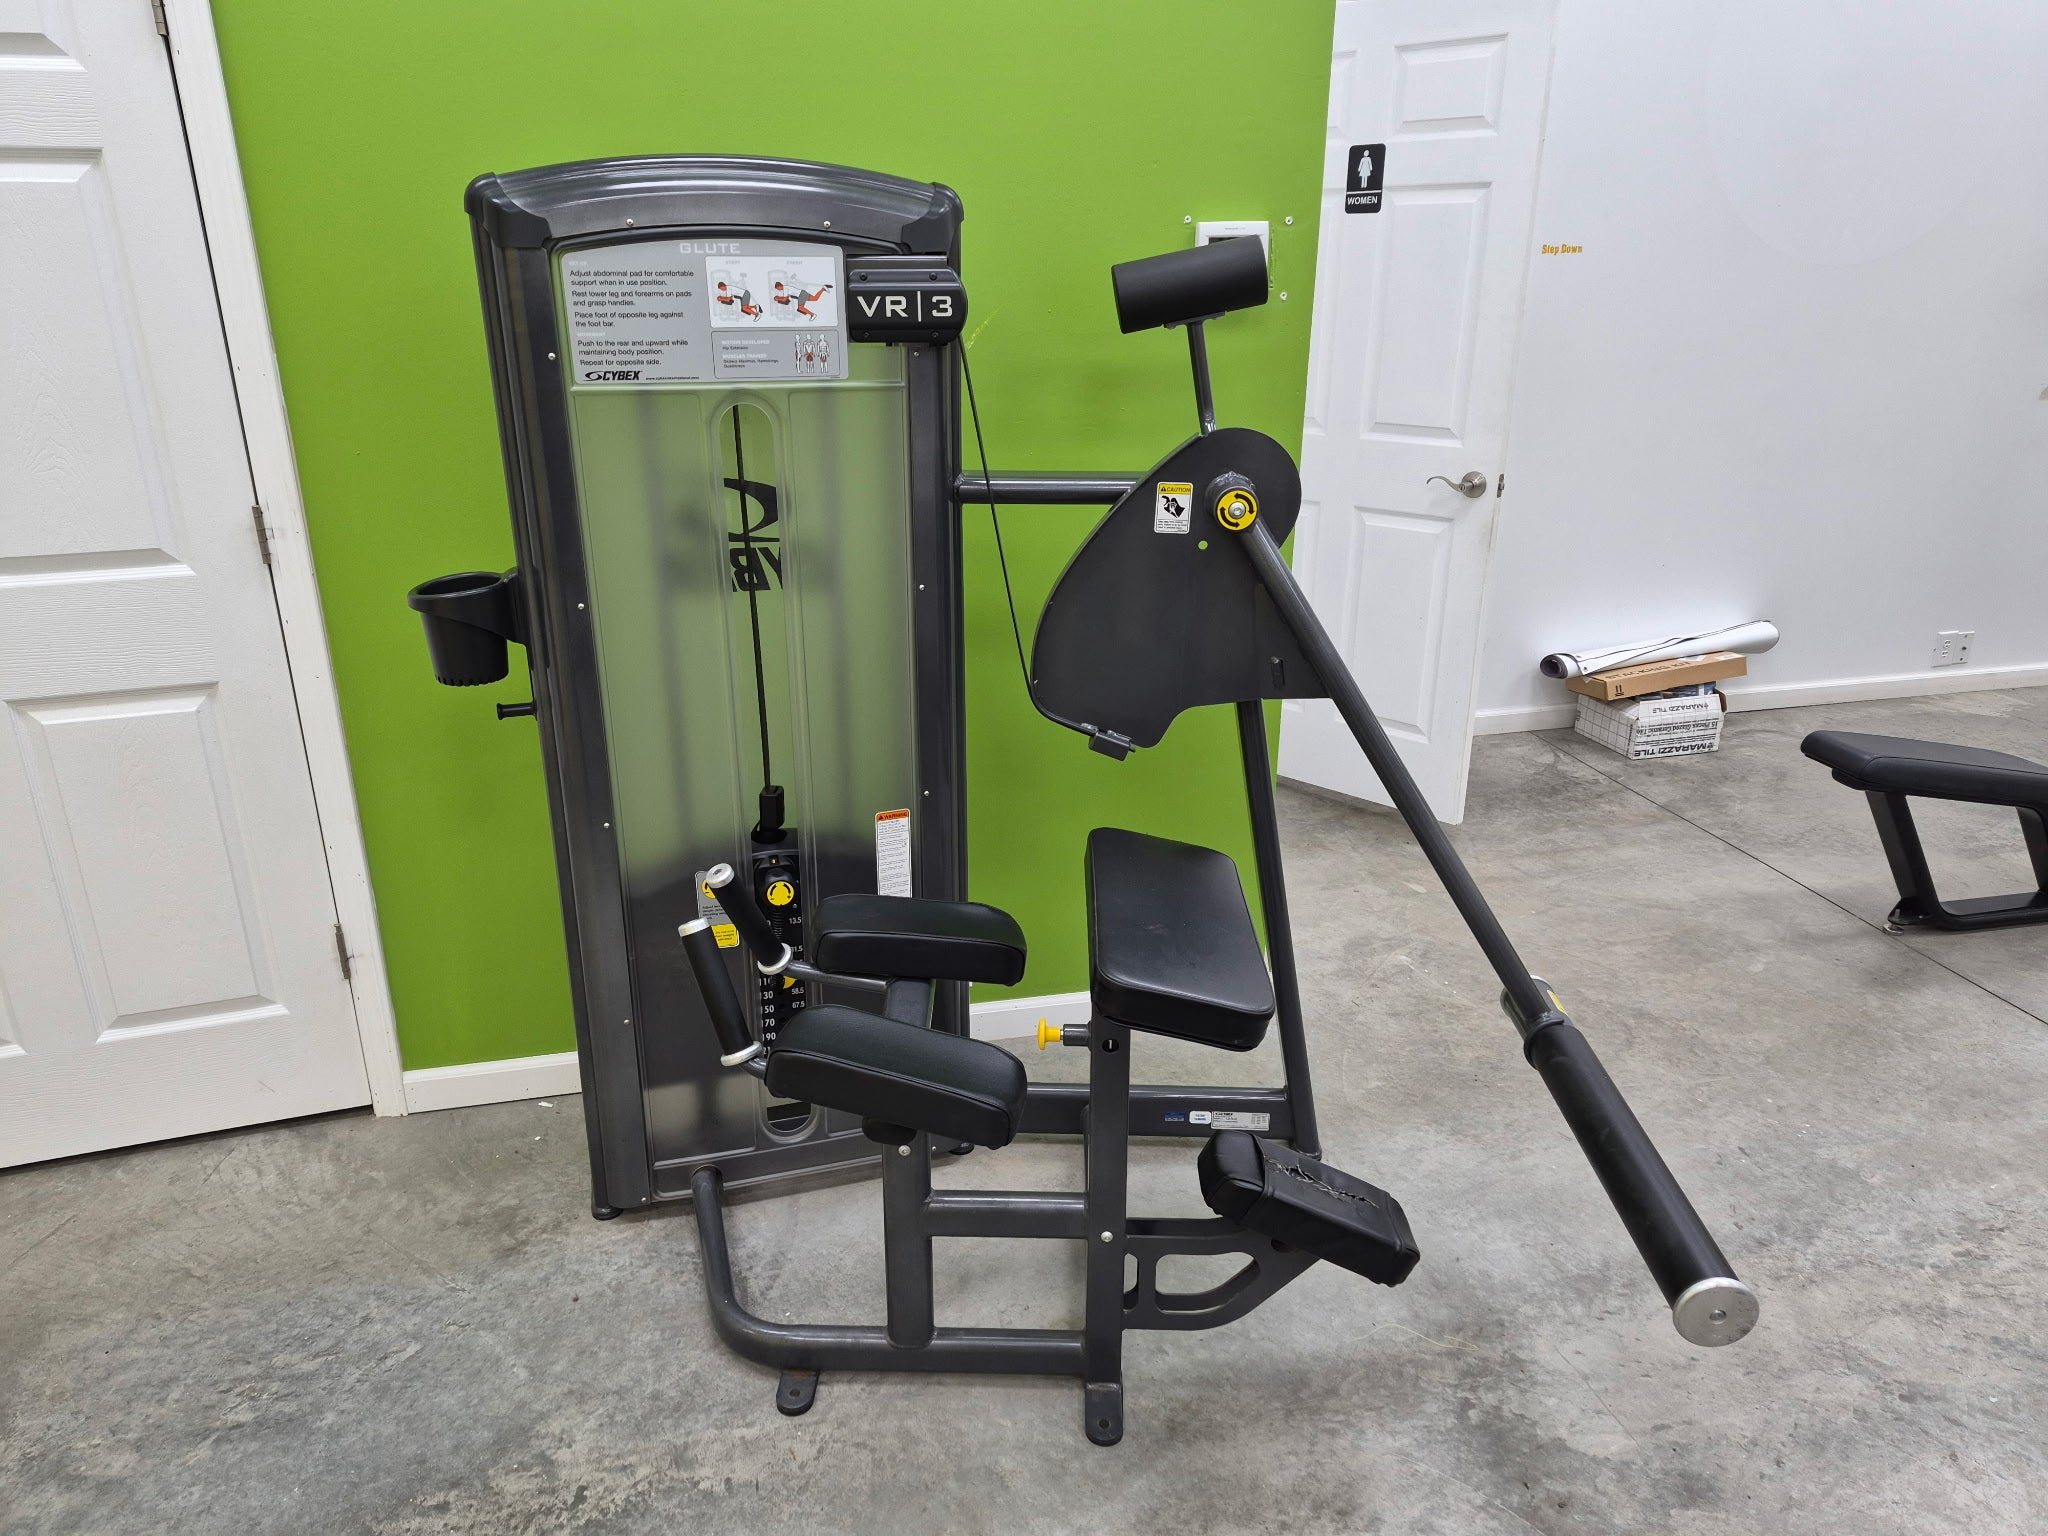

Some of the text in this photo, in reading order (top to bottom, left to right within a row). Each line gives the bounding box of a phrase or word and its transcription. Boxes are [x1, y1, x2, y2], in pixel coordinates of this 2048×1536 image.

[1347, 195, 1378, 205] WOMEN
[679, 242, 741, 254] GLUTE
[1541, 244, 1582, 256] Step Down
[609, 290, 619, 298] leg
[675, 290, 692, 298] pads
[618, 311, 647, 319] opposite
[648, 311, 659, 319] leg
[660, 311, 684, 319] against
[645, 339, 670, 347] upward
[602, 370, 641, 381] CYBEX
[1669, 703, 1704, 712] MARAZZI
[1648, 725, 1671, 733] Ceramic
[1672, 723, 1692, 731] Glazed
[1658, 742, 1707, 754] MARAZZI
[1634, 749, 1656, 757] TILE
[884, 811, 908, 820] WARNING
[789, 916, 802, 925] 13.5
[791, 986, 805, 995] 58.5
[792, 1000, 806, 1009] 67.5
